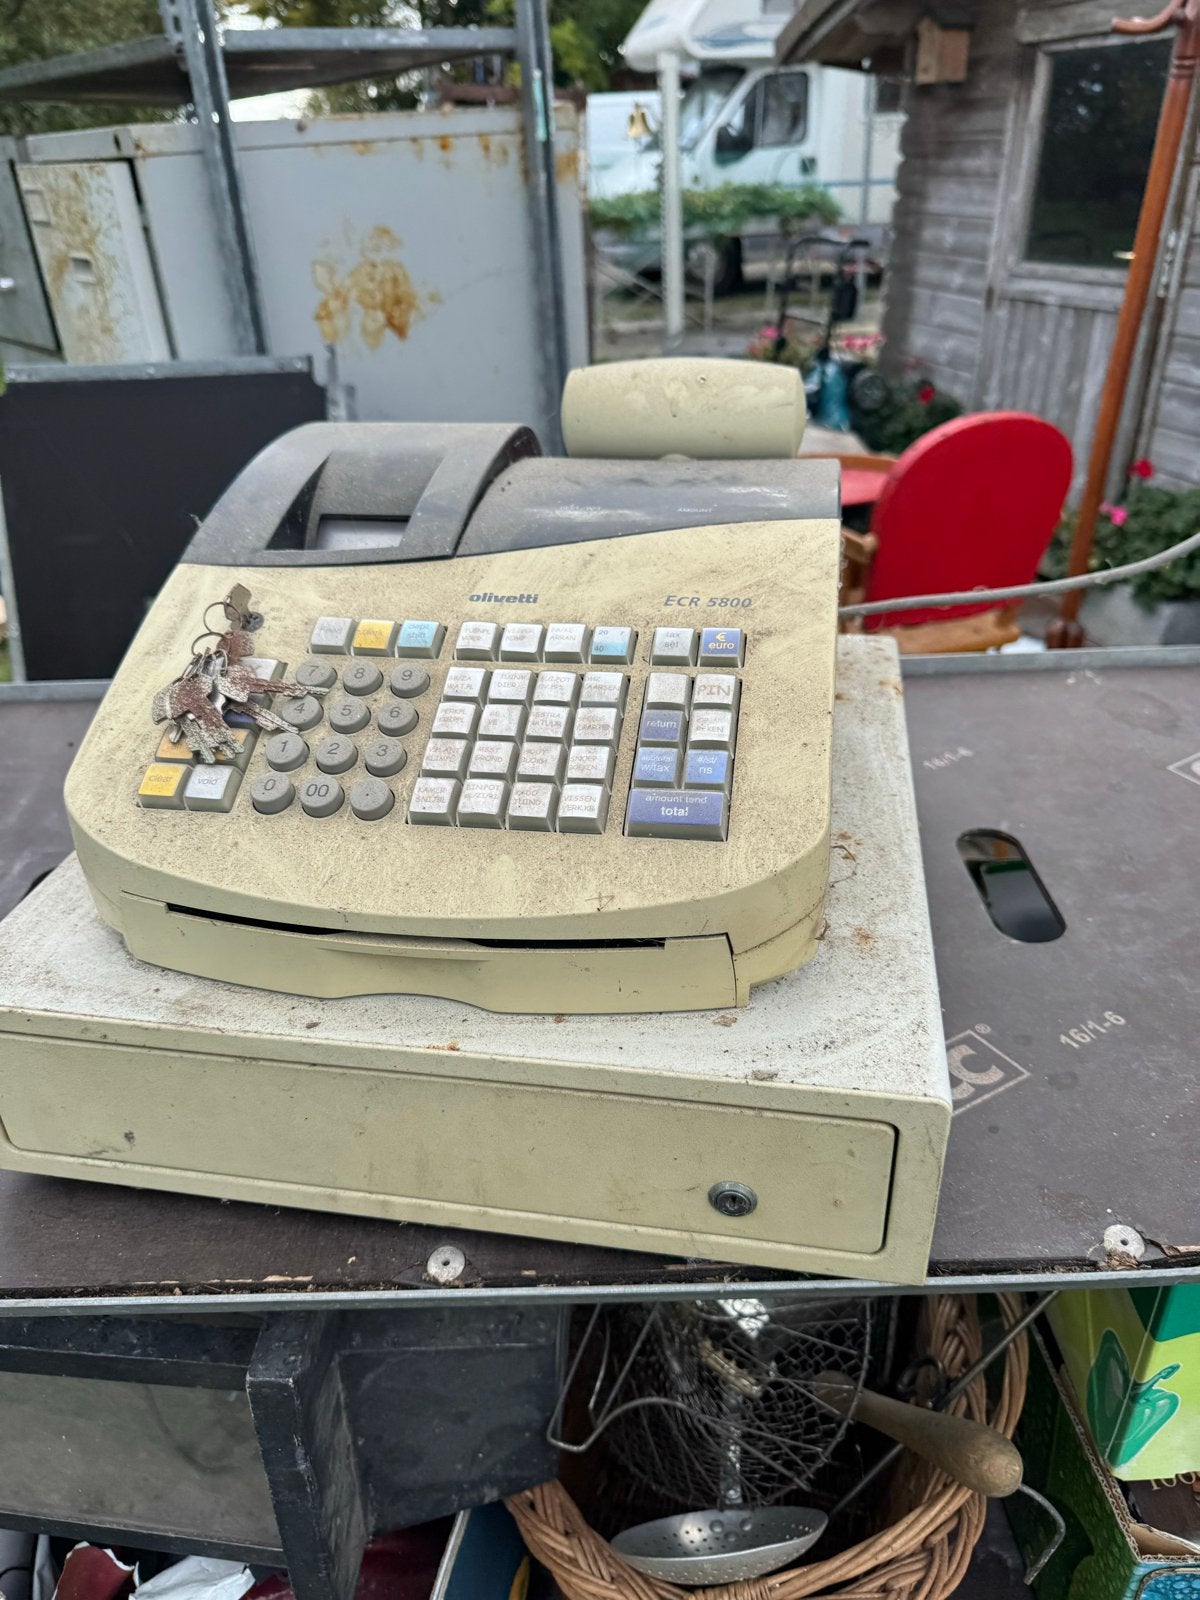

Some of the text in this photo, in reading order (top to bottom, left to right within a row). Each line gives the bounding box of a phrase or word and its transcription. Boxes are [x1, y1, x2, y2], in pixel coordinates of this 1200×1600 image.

[468, 592, 539, 604] olivetti
[663, 595, 752, 608] ECR 5800
[708, 642, 735, 650] euro
[306, 665, 319, 677] 7
[354, 667, 366, 679] 8
[402, 669, 414, 681] 9
[697, 684, 731, 697] PIN
[294, 702, 306, 714] 4
[341, 704, 353, 716] 5
[389, 706, 401, 718] 6
[646, 720, 677, 729] return
[280, 740, 289, 753] 1
[326, 742, 340, 755] 2
[376, 744, 389, 757] 3
[641, 763, 670, 772] w/tax
[148, 774, 173, 783] clear
[198, 777, 219, 786] void
[263, 779, 276, 791] 0
[306, 783, 330, 797] 00
[563, 795, 597, 803] VISSEN
[645, 793, 708, 804] amount tend
[661, 806, 689, 816] total
[1059, 1010, 1127, 1050] 16/1-6
